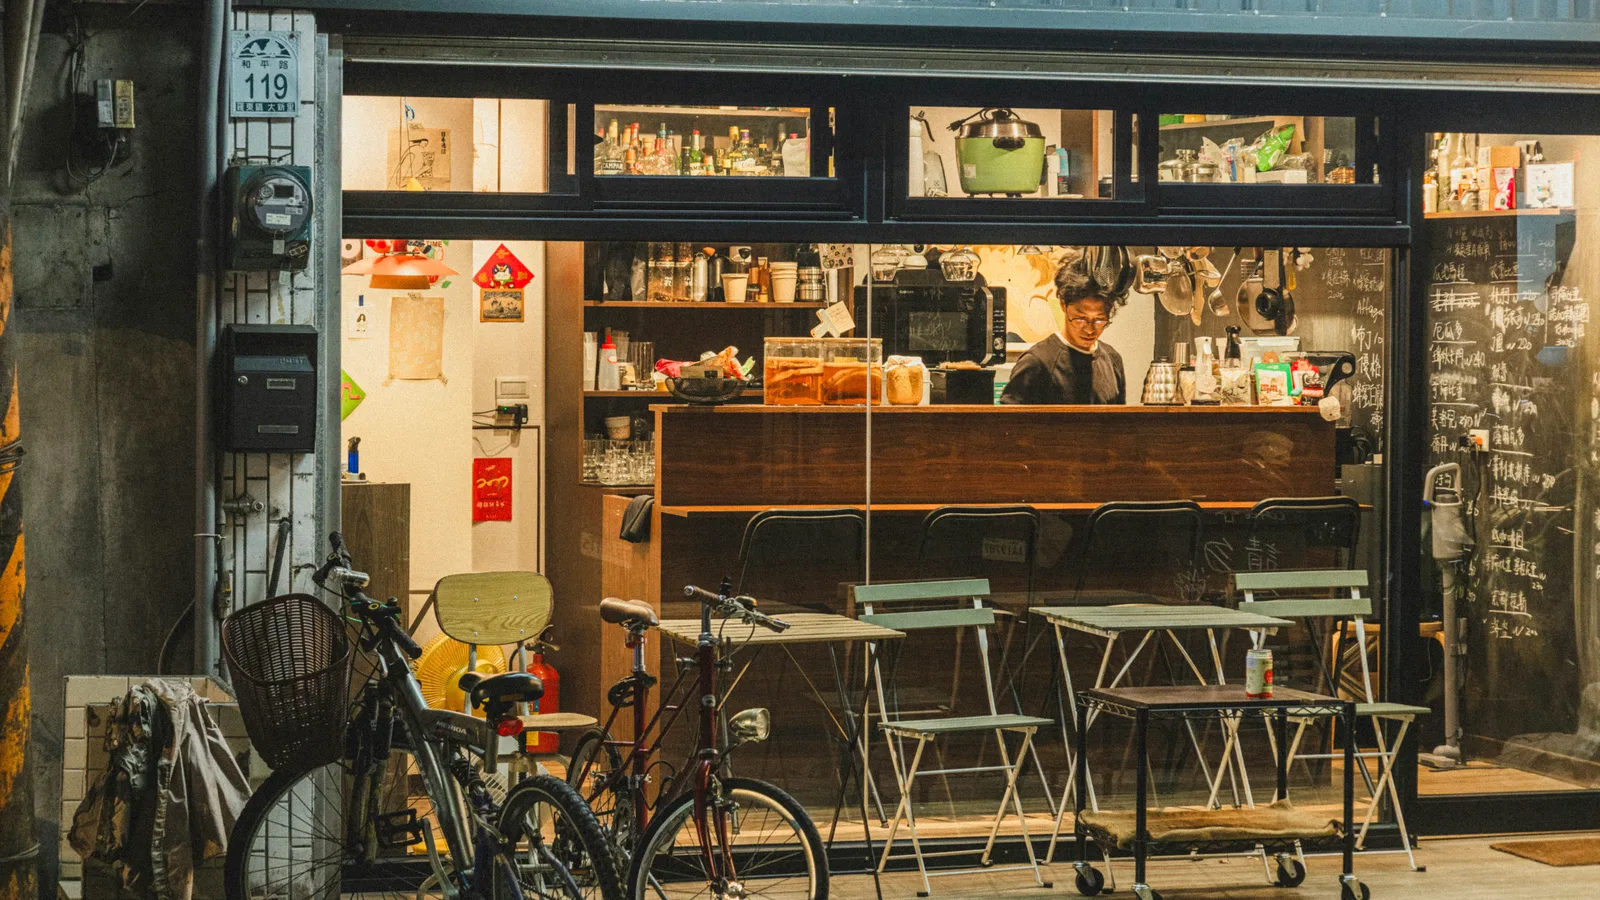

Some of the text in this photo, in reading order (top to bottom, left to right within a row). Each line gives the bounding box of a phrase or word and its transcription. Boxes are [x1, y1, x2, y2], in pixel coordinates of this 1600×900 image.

[241, 60, 289, 69] 和平路
[245, 72, 288, 100] 119
[436, 720, 467, 735] MERIDA
